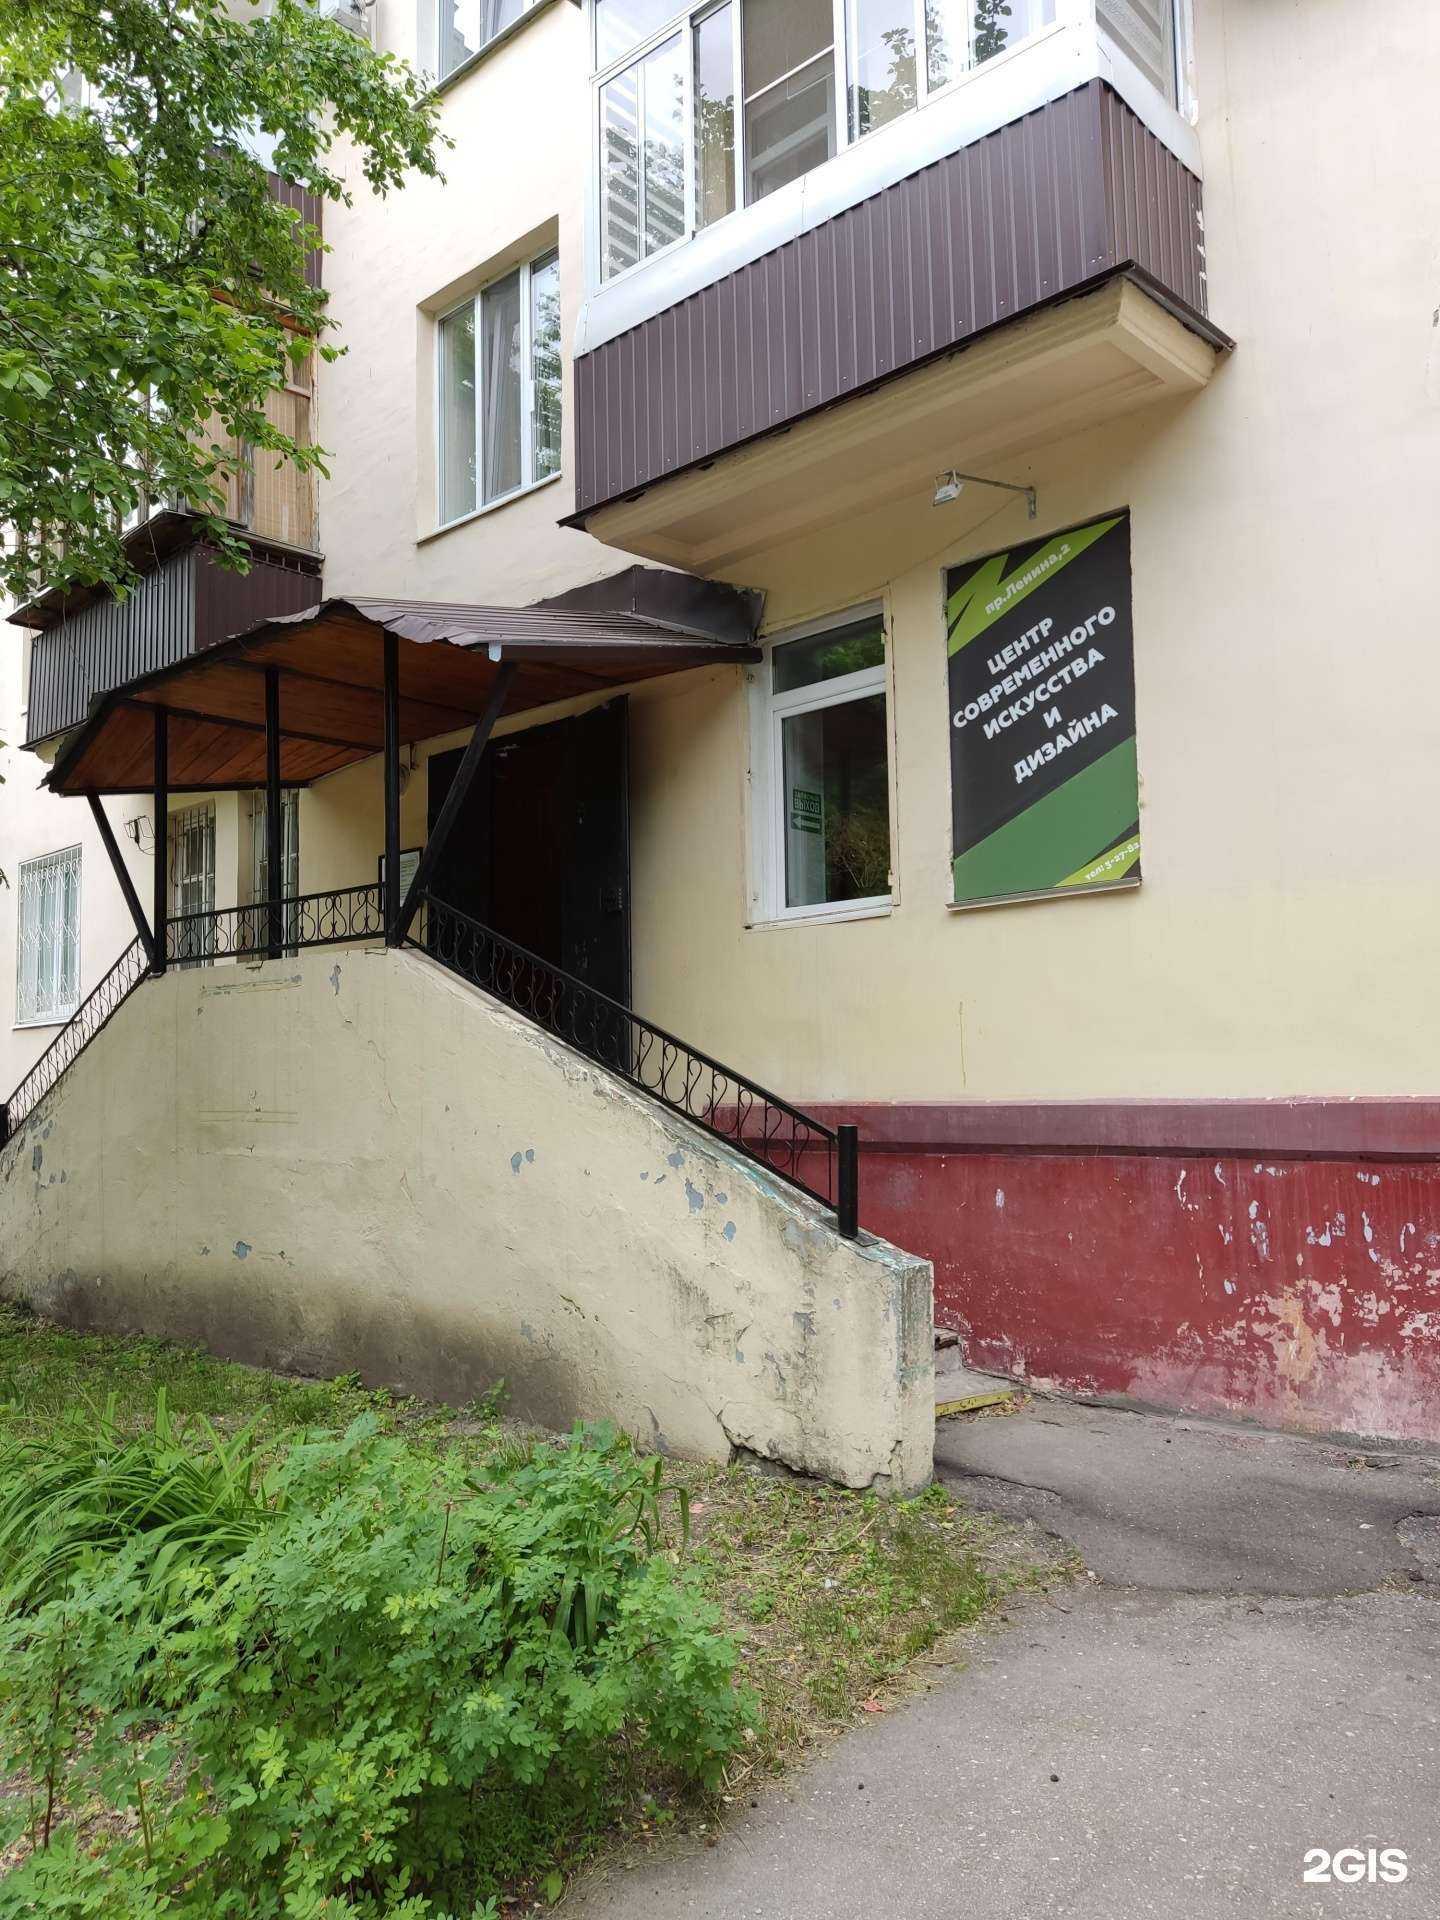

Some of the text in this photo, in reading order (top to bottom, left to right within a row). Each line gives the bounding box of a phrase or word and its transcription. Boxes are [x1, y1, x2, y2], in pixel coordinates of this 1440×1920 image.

[953, 606, 1116, 728] СОВРЕМЕННОГО
[987, 618, 1053, 675] ЦЕНТР
[983, 648, 1106, 740] ИСКУССТВА
[1043, 706, 1063, 729] И
[1013, 703, 1119, 784] ДИЗАЙНА
